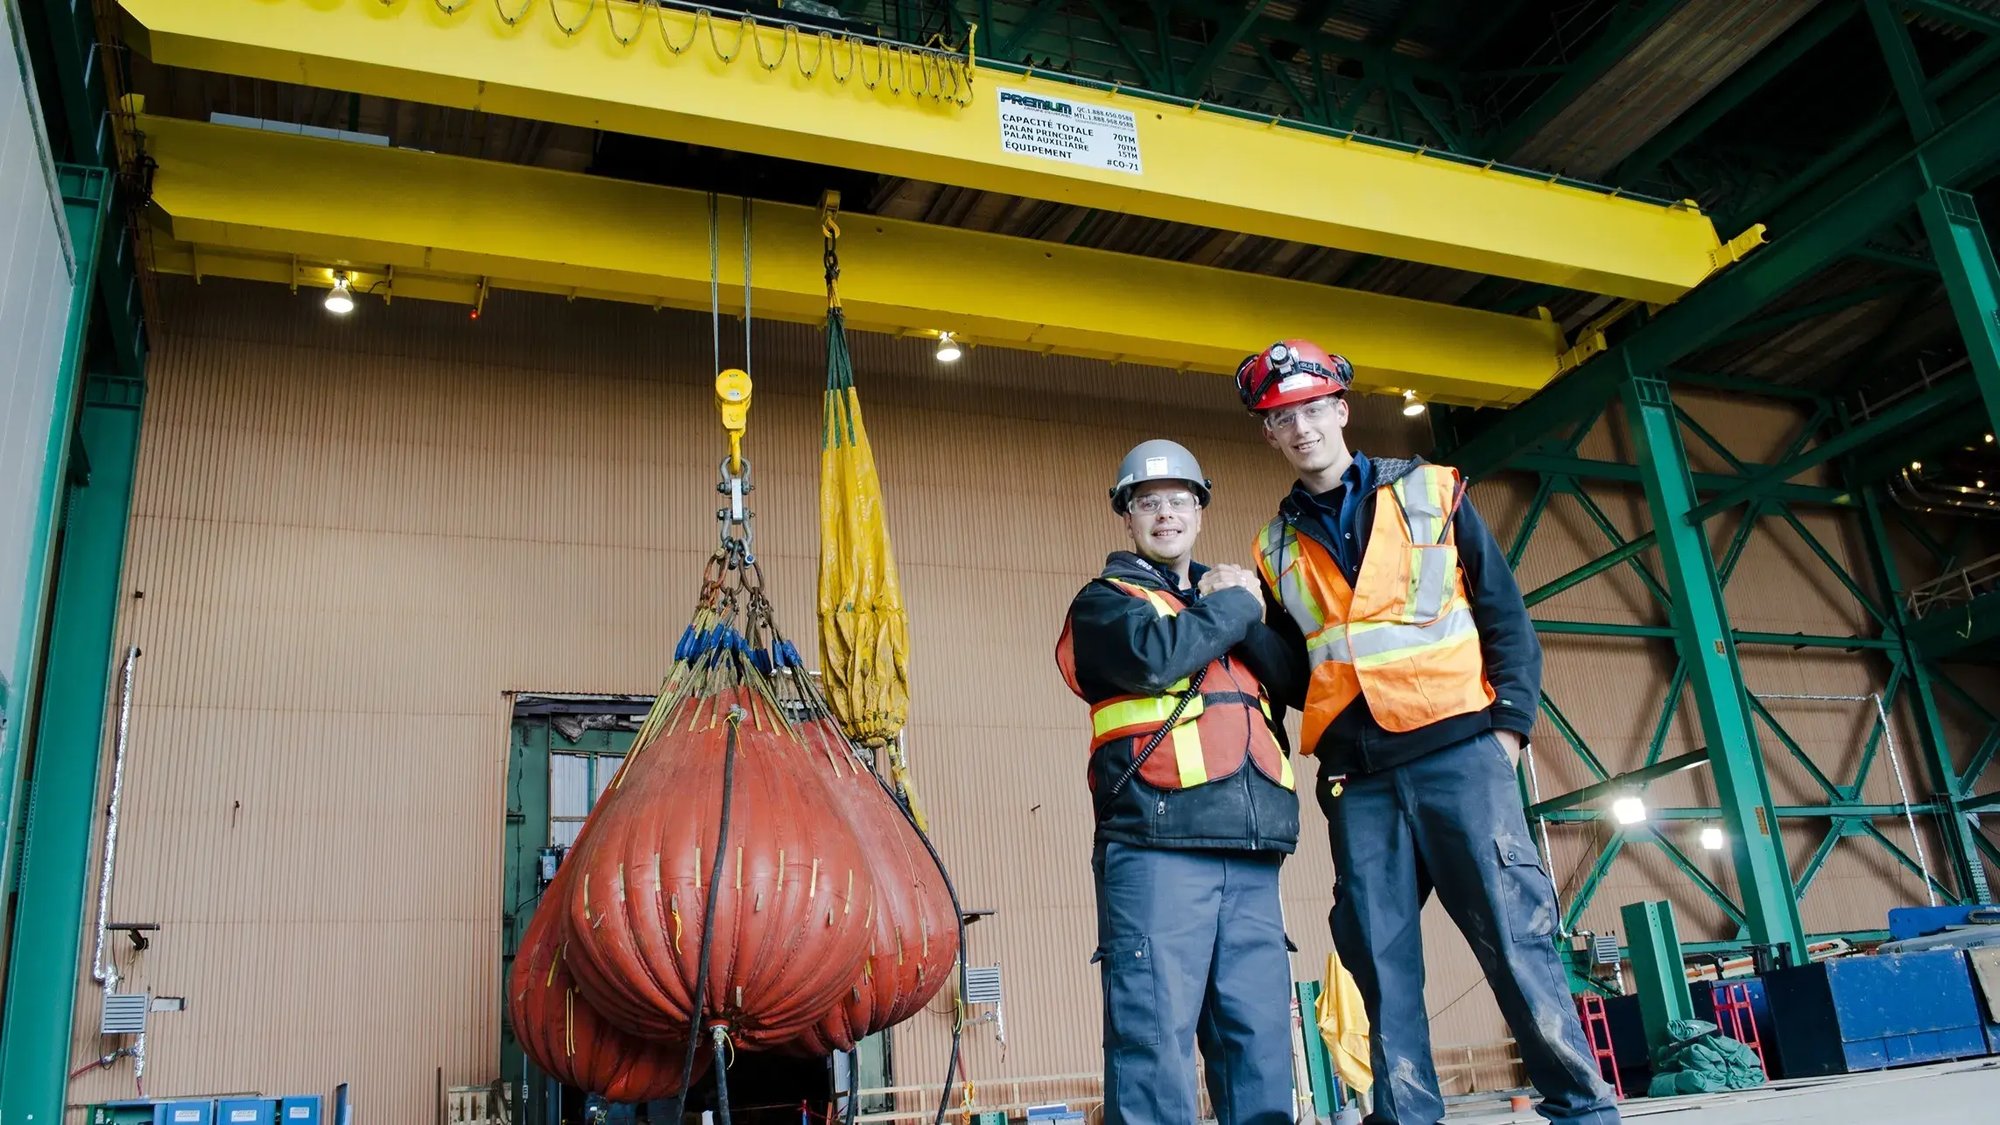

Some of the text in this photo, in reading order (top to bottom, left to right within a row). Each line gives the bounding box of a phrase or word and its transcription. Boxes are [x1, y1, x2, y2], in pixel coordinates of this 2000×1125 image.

[1001, 92, 1072, 115] PREMIUM
[1002, 113, 1053, 129] CAPACITÉ
[1056, 122, 1094, 137] TOTALE
[1112, 133, 1136, 144] 70TM
[1003, 123, 1137, 152] PALAN PRINCIPAL 70TM
[1004, 130, 1138, 160] PALAN AUXILIAIRE 15TM
[1005, 139, 1138, 171] ÉQUIPEMENT #CO-71
